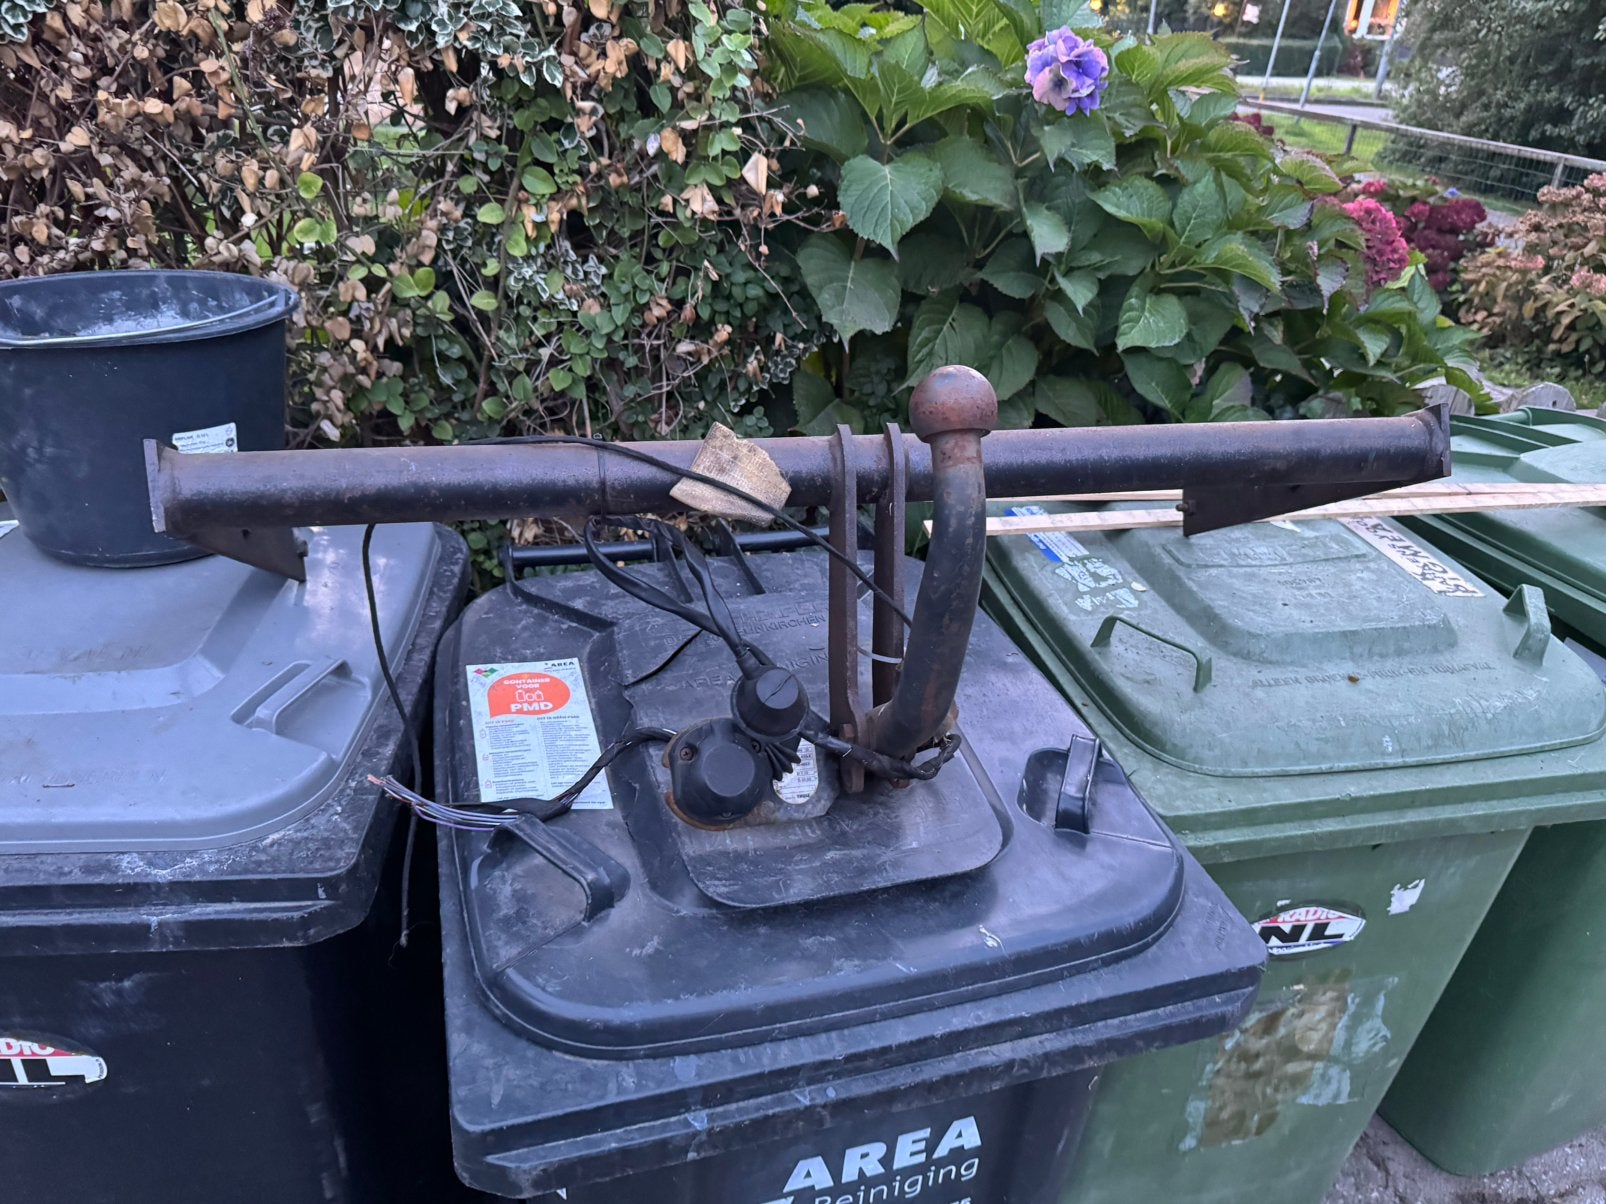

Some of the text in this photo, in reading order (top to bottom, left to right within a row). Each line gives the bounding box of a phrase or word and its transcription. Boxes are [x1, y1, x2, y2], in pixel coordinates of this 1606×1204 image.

[510, 701, 553, 712] PMD
[1259, 921, 1345, 945] NL
[0, 1058, 86, 1084] L
[782, 1115, 982, 1193] AREA
